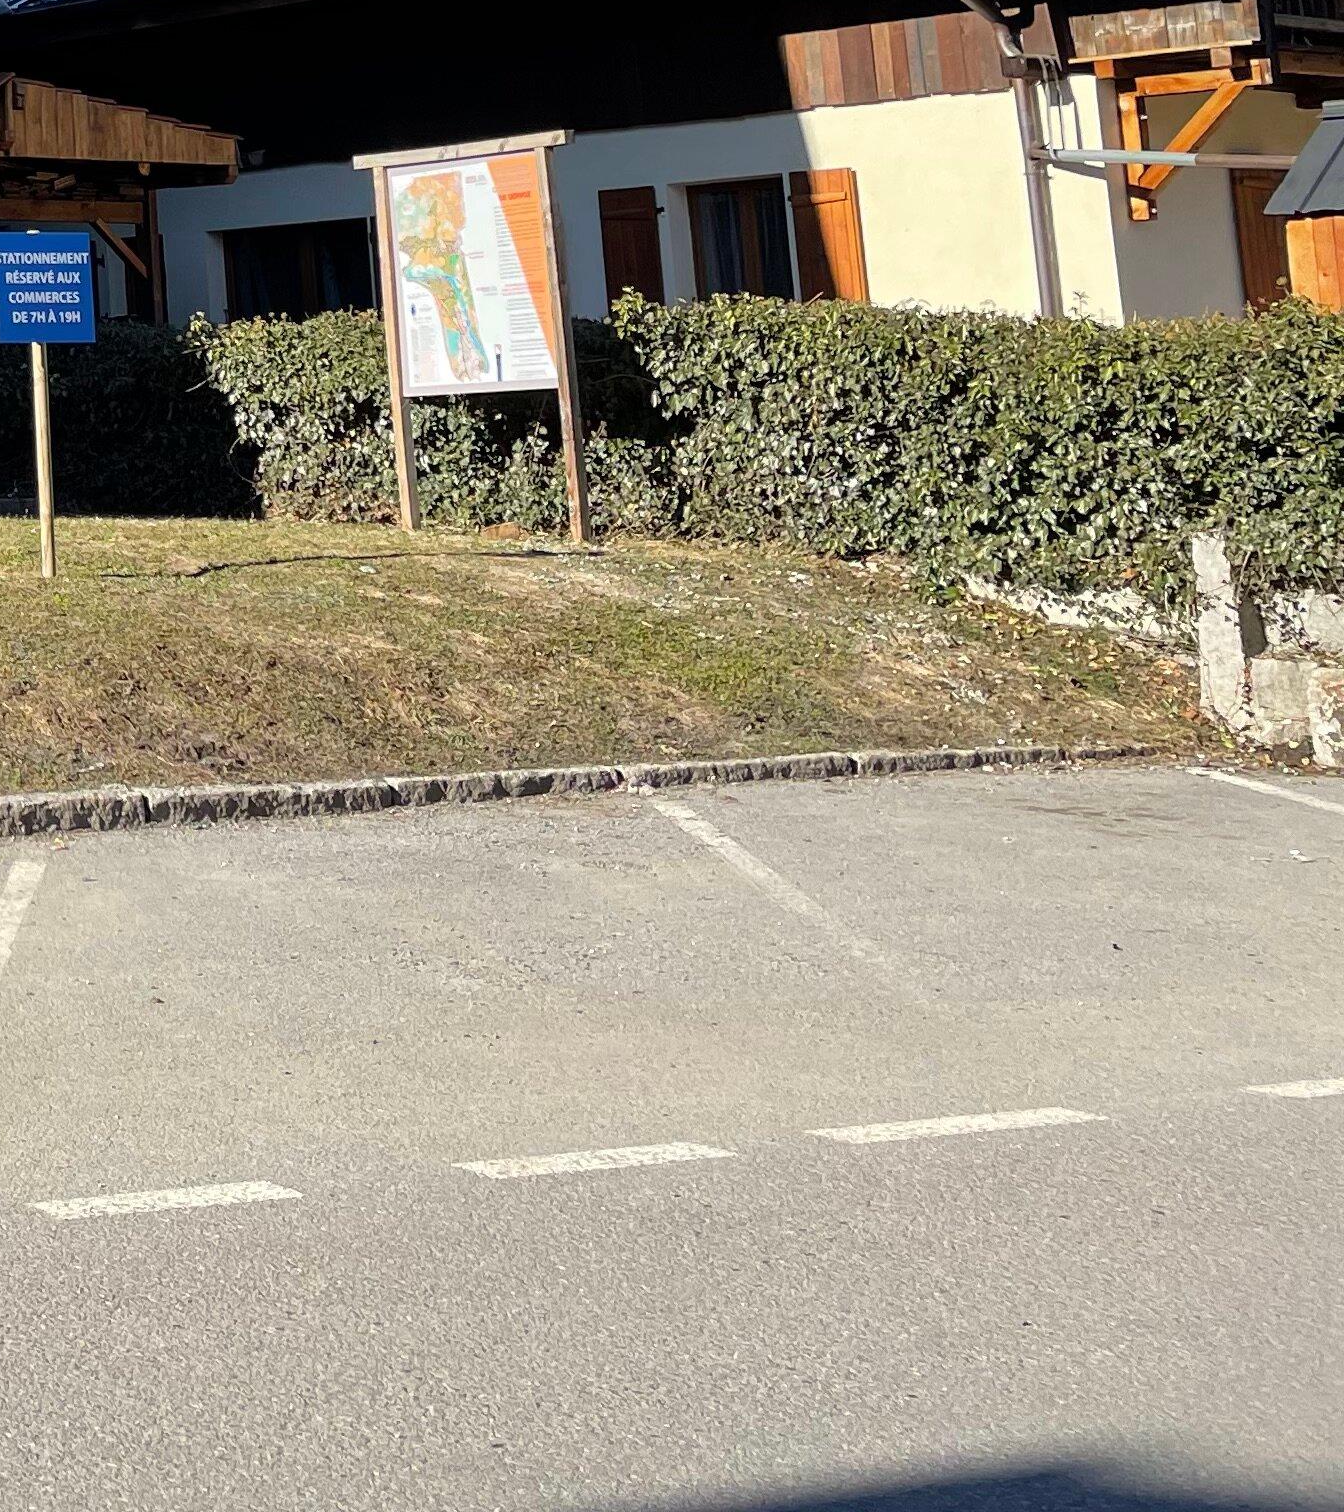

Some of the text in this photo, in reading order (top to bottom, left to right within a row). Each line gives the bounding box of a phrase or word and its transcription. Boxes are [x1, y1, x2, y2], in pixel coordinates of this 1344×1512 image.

[5, 270, 81, 284] RÉSERVÉ AUX
[8, 292, 80, 303] COMMERCES
[12, 308, 81, 323] DE 7H À 19H
